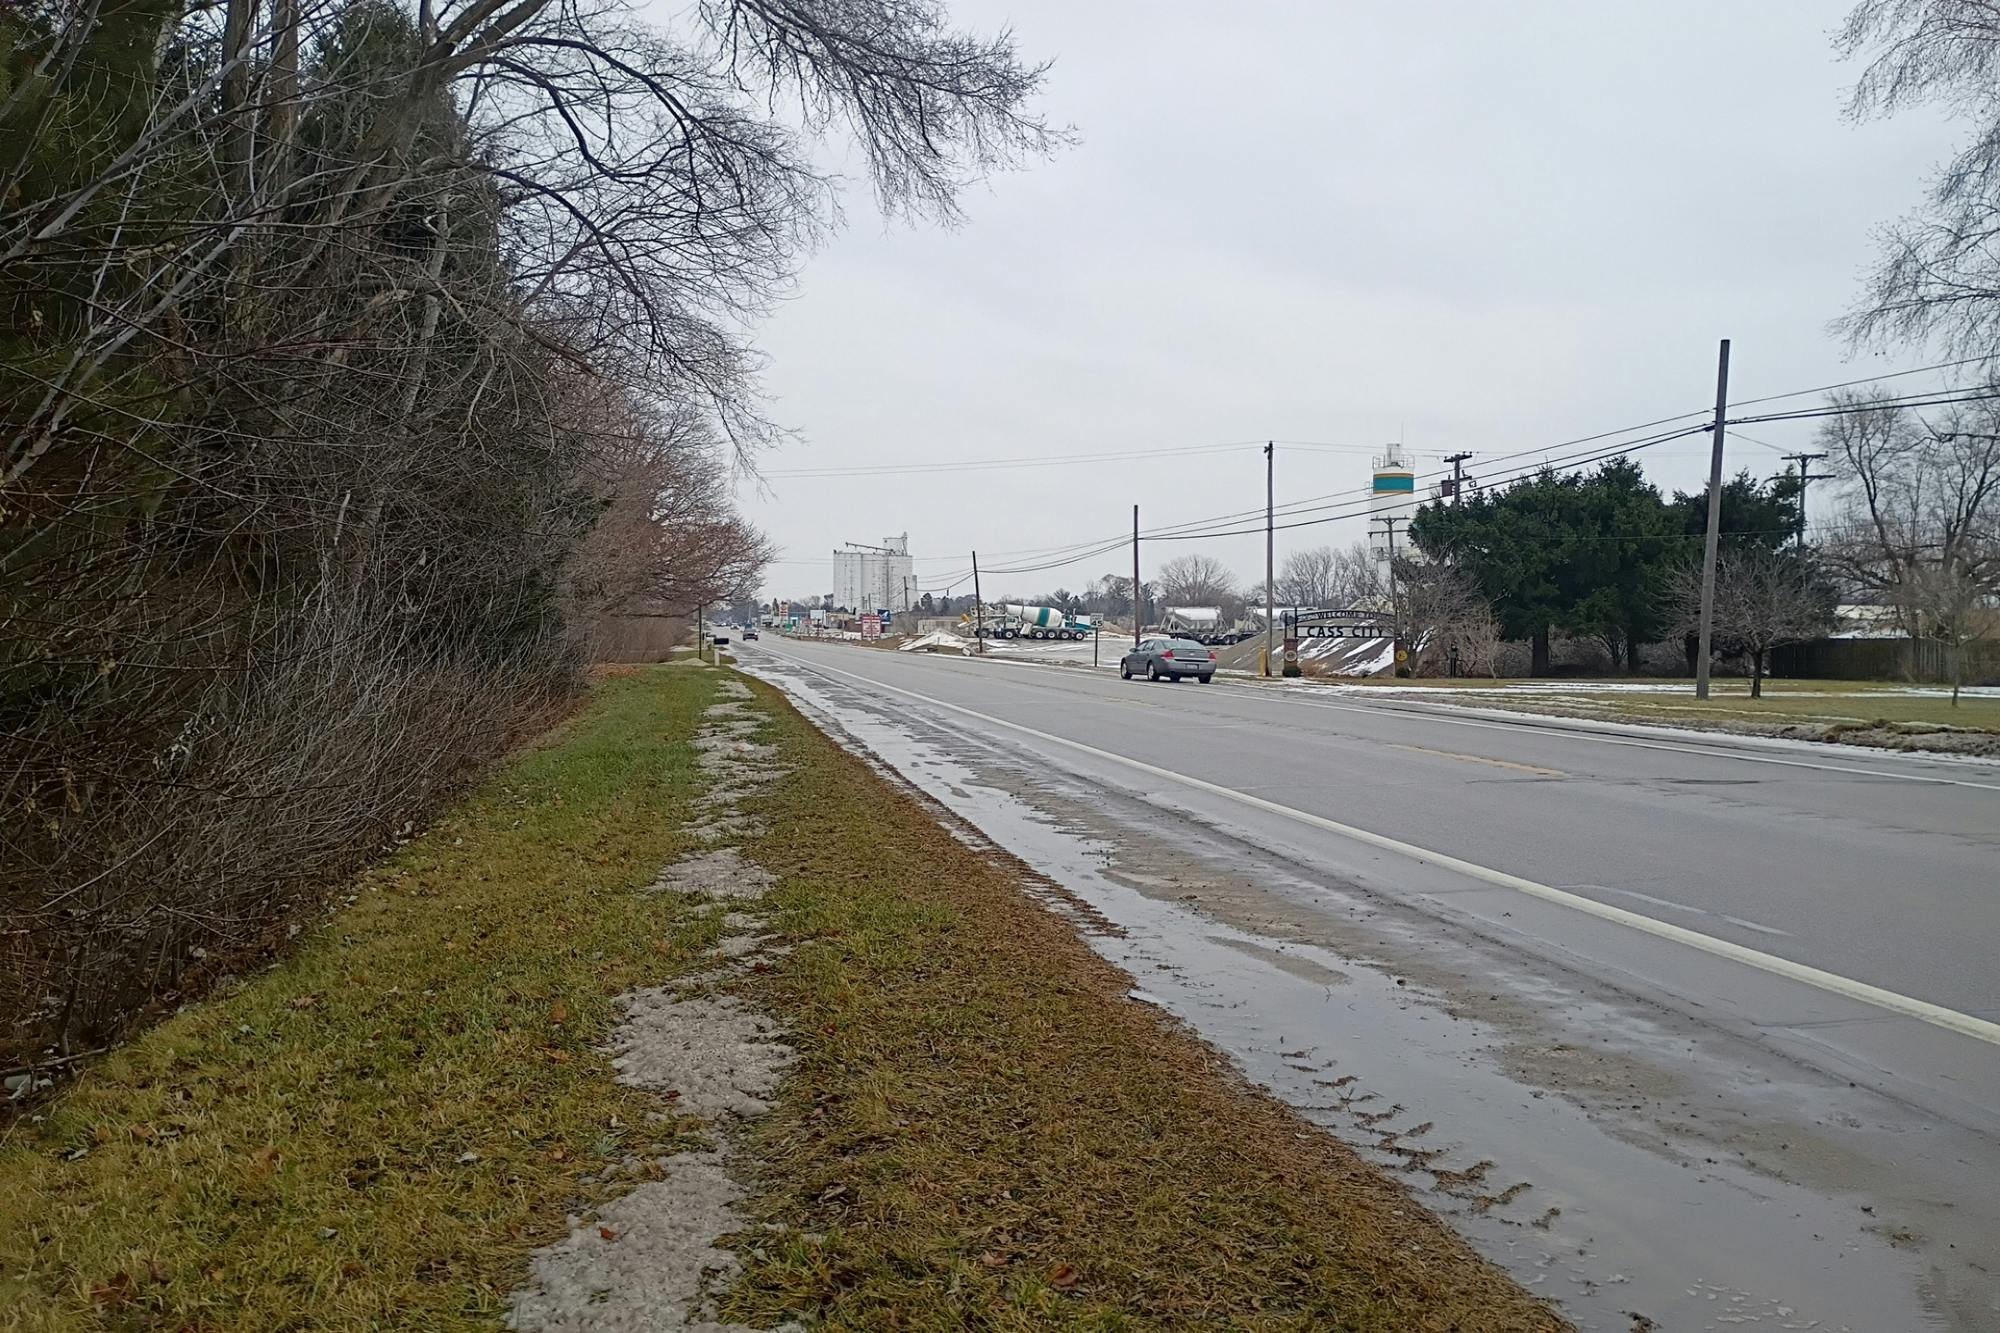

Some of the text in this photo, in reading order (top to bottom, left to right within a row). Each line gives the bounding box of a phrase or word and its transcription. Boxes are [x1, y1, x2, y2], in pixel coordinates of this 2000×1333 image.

[1318, 611, 1358, 619] WELCOME
[1307, 626, 1383, 637] CASS CITY
